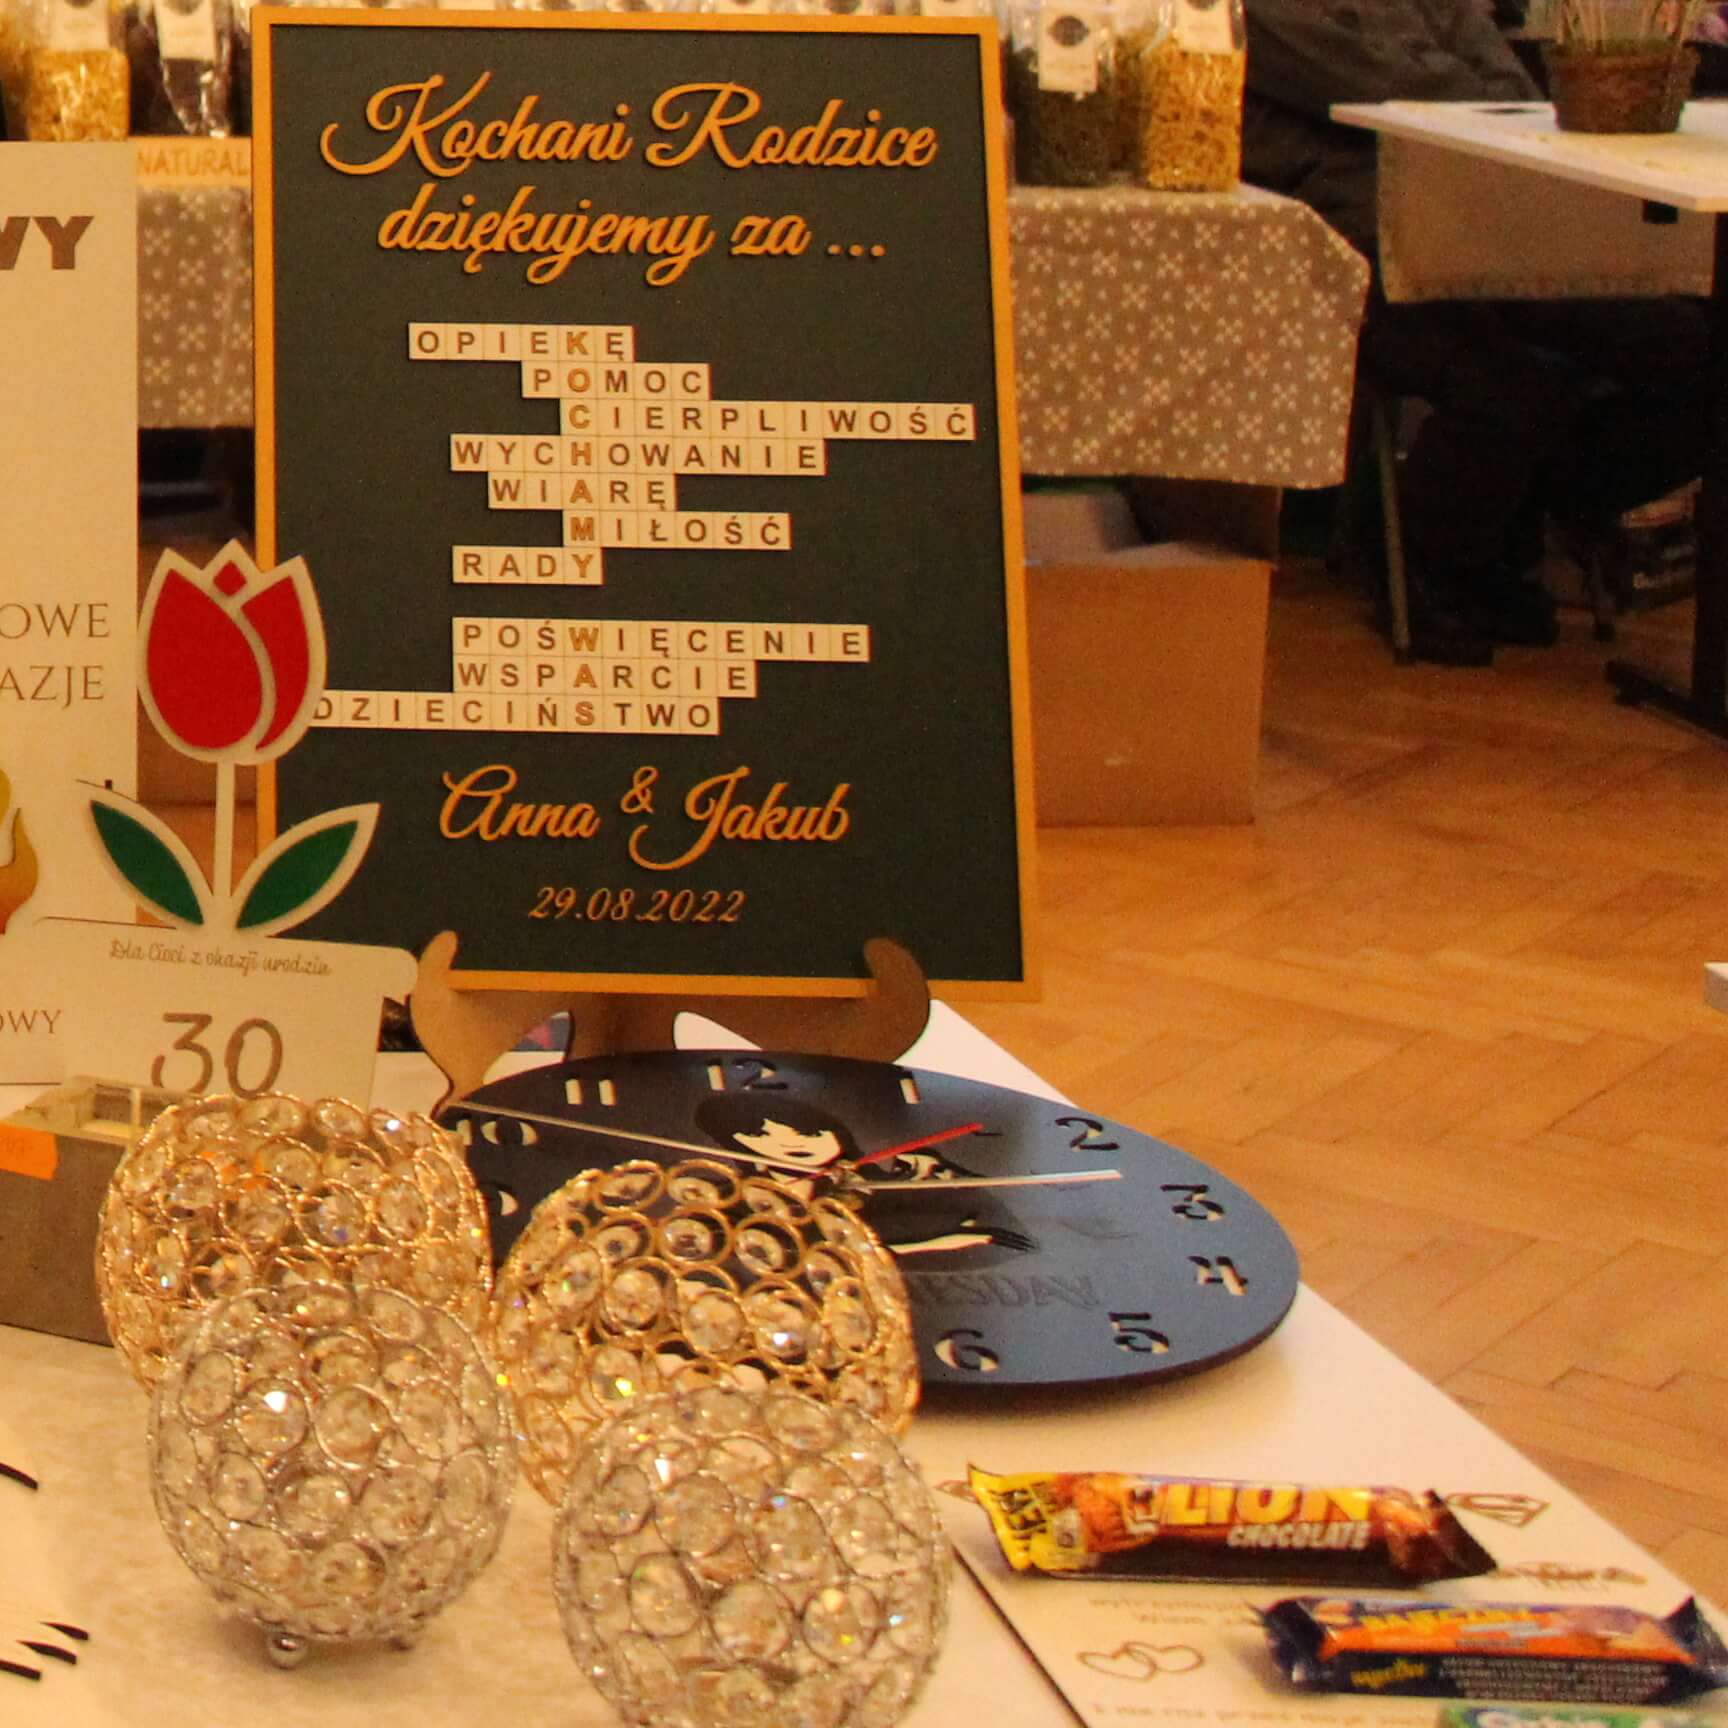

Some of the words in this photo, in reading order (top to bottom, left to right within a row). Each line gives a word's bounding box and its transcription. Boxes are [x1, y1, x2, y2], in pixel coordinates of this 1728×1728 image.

[320, 72, 634, 176] Kochani
[644, 81, 939, 169] Rodzice
[378, 183, 715, 286] dziękujemy
[730, 212, 813, 258] za
[417, 328, 627, 362] OPIEKĘ
[535, 368, 703, 395] POMOC
[570, 403, 969, 437] CIERPLIWOŚĆ
[455, 441, 818, 470] WYCHOWANIE
[493, 477, 667, 512] WIARĘ
[571, 516, 783, 546] MIŁOŚĆ
[461, 553, 592, 579] RADY
[463, 619, 863, 659] POŚWIĘCENIE
[458, 662, 749, 692] WSPARCIE
[439, 765, 601, 843] Anna
[620, 765, 654, 814] &
[628, 767, 851, 872] Jakub
[528, 886, 747, 924] 29.08.2022
[109, 939, 144, 960] Dla
[150, 1012, 284, 1099] 30
[1164, 1483, 1370, 1526] LION
[1229, 1521, 1371, 1551] CHOCOLATE
